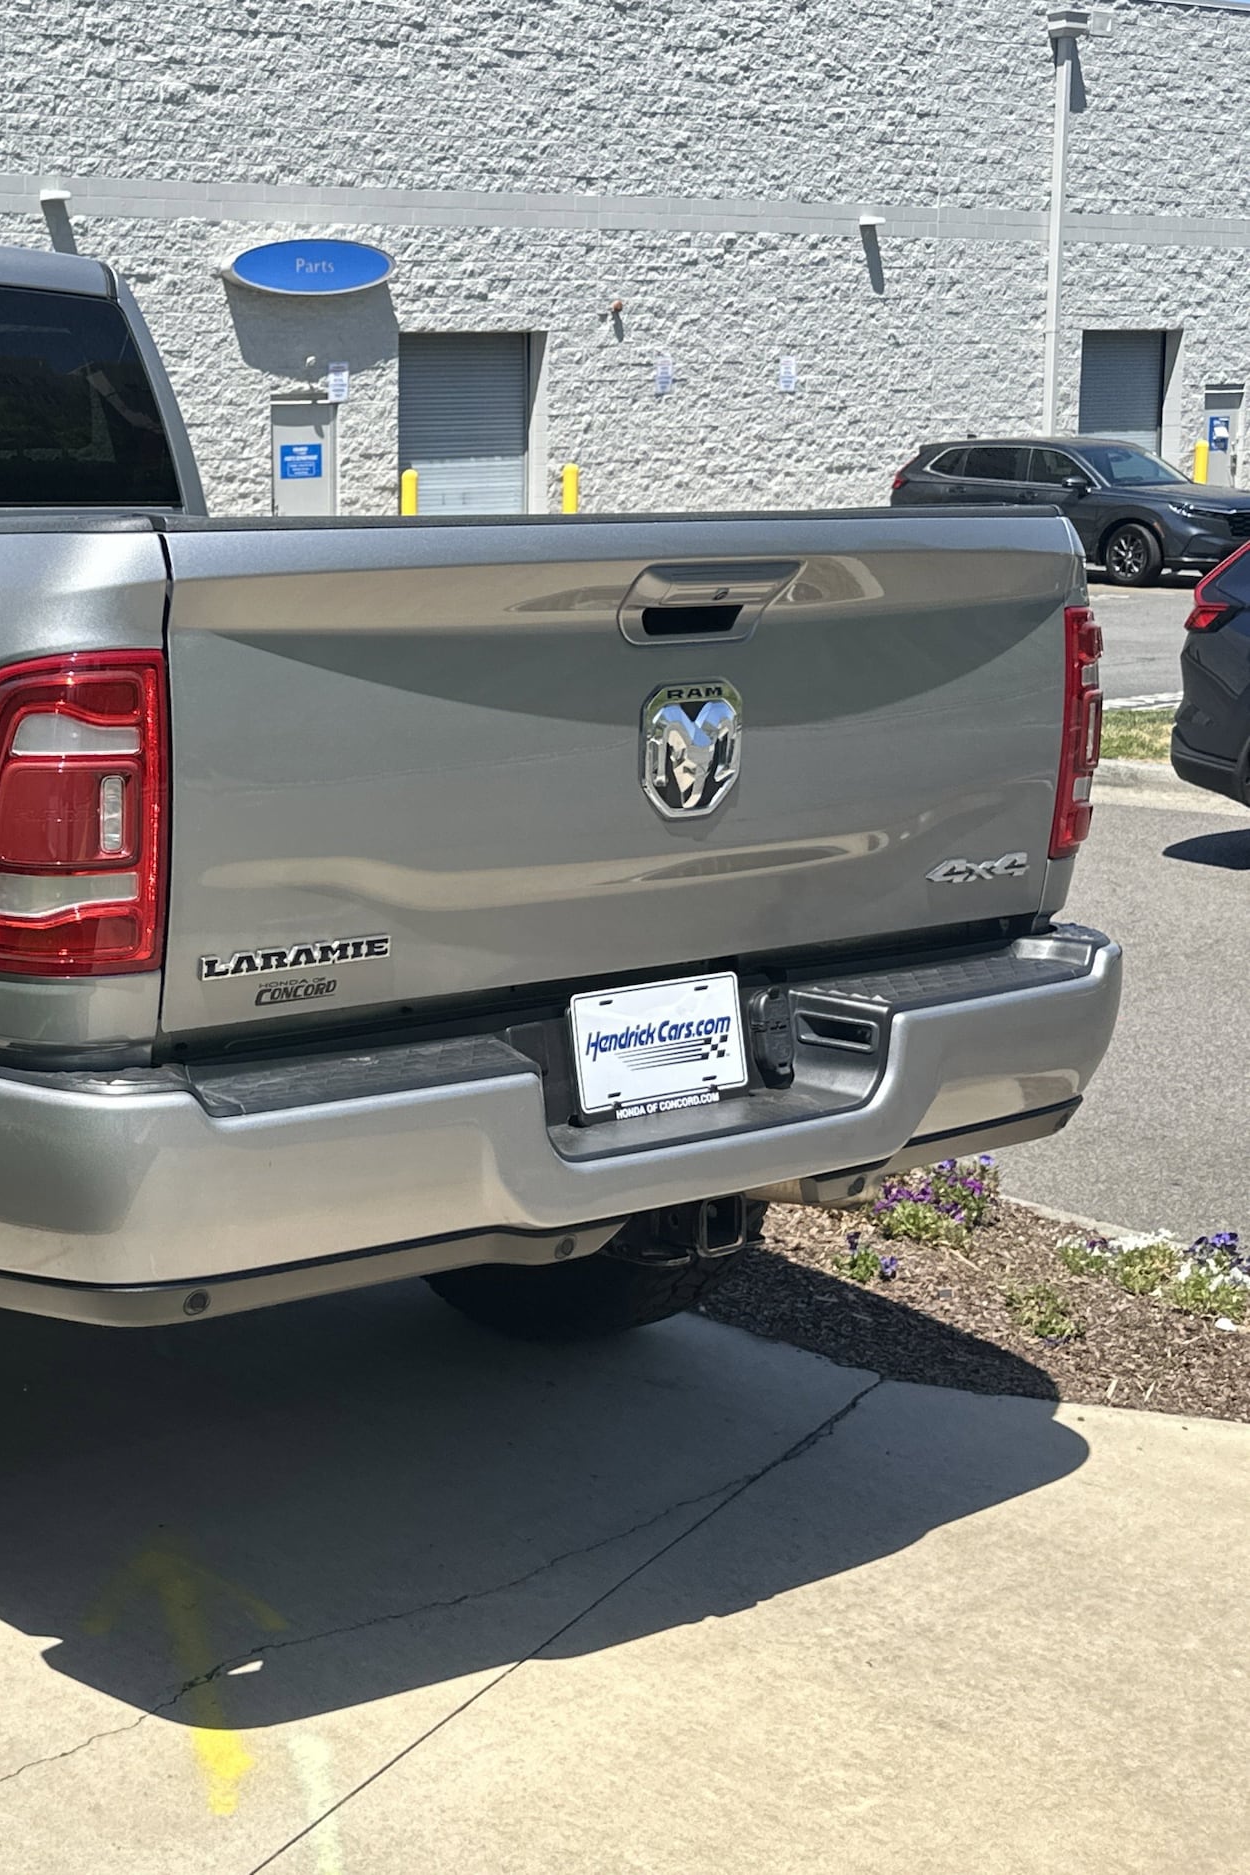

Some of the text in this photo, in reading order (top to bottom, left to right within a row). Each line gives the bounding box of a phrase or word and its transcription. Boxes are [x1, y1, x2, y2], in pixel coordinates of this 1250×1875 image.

[295, 257, 335, 273] Parts
[667, 687, 723, 699] RAM
[200, 935, 391, 981] LARAMIE
[255, 979, 337, 1006] CONCORD
[258, 978, 310, 989] HONDA
[615, 1092, 720, 1120] HONDA OF CONCORD.COM
